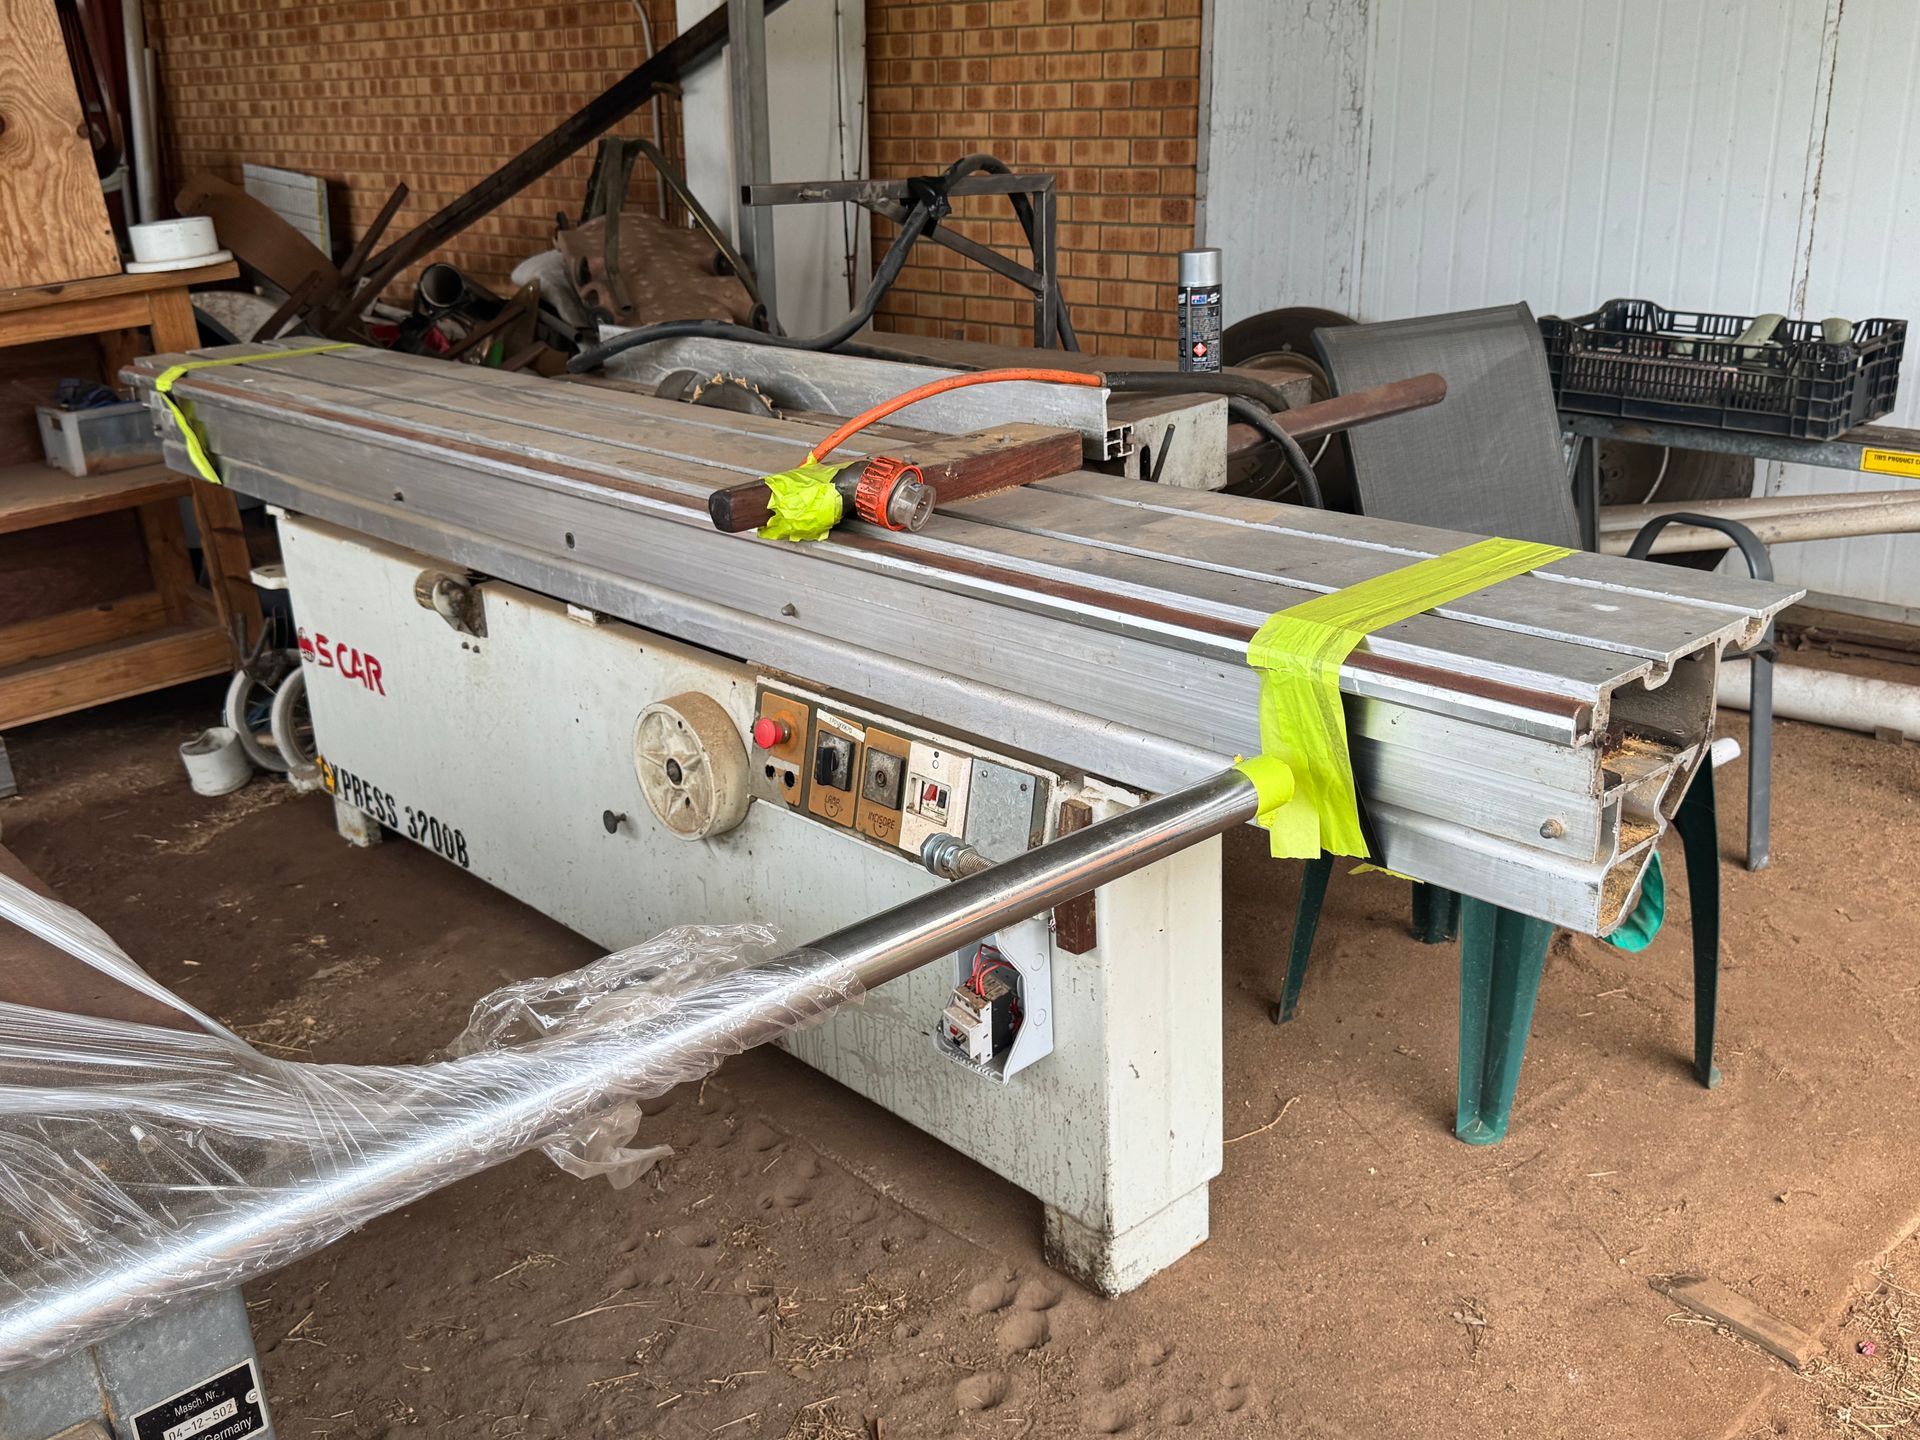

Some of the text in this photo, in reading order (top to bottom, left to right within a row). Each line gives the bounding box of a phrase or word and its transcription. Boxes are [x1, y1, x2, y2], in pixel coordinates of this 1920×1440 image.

[1888, 456, 1914, 464] PRODUCT
[320, 754, 398, 829] EXPRESS
[868, 811, 896, 830] INCISORE
[174, 1390, 219, 1417] Masch. Nr.
[204, 1416, 252, 1440] Germany
